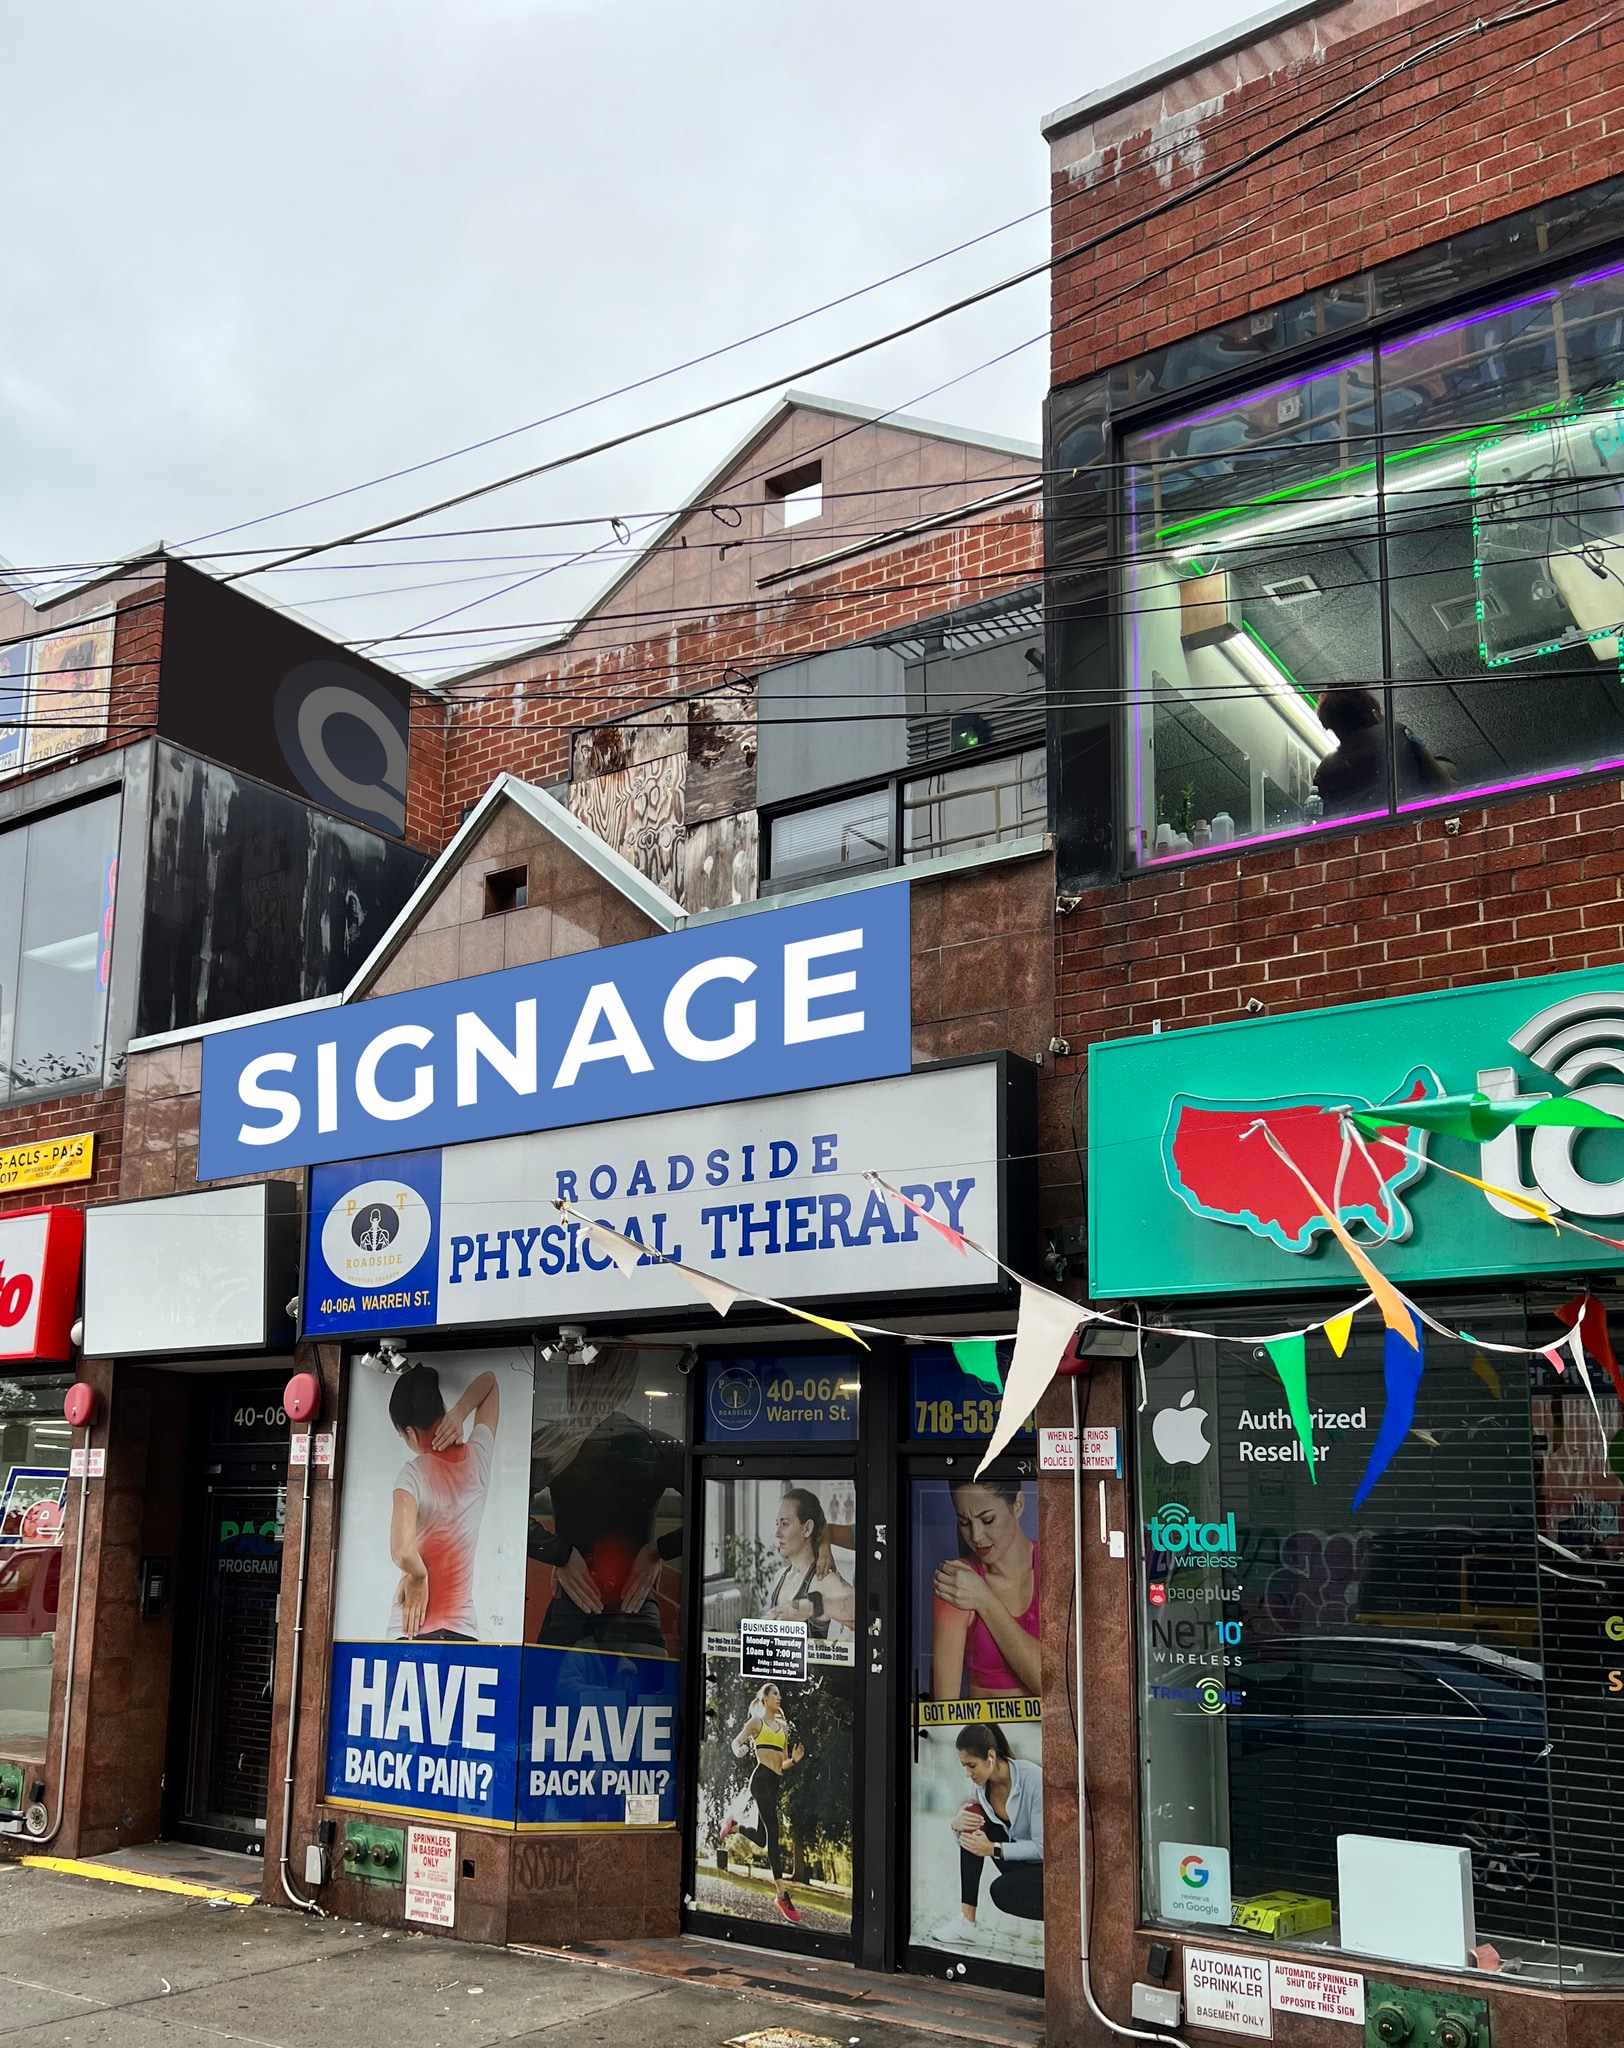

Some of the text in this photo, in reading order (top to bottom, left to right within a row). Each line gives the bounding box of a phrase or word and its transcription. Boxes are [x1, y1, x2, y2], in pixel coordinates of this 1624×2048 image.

[236, 927, 865, 1146] SIGNAGE
[52, 1143, 83, 1160] PALS
[555, 1133, 838, 1203] ROADSIDE
[346, 1193, 408, 1217] P T
[449, 1177, 975, 1284] PHYSICAL THERAPY
[346, 1254, 403, 1269] ROADSIDE
[320, 1290, 431, 1314] 40-06A WARREN ST.
[766, 1378, 850, 1402] 40-06A
[234, 1406, 286, 1426] 40-06
[766, 1404, 850, 1422] Warren St.
[1237, 1406, 1366, 1430] Authrized
[1047, 1431, 1067, 1440] WHEN
[1087, 1431, 1109, 1440] RINGS
[1055, 1444, 1073, 1453] CALL
[1090, 1443, 1101, 1453] OR
[1043, 1456, 1114, 1466] POLICE DARTMENT
[1146, 1511, 1237, 1553] total
[218, 1558, 279, 1574] PROGRAM
[1174, 1552, 1239, 1568] wireless
[1168, 1585, 1241, 1604] pageplus
[743, 1622, 805, 1635] BUSINESS HOURS
[746, 1636, 770, 1647] Monday
[774, 1637, 802, 1649] Thursday
[746, 1647, 802, 1660] 10am to 7:00 pm
[1153, 1652, 1242, 1667] WIRELESS
[347, 1657, 499, 1752] HAVE
[923, 1699, 1041, 1721] GOT PAIN? TIENE DO
[530, 1706, 673, 1763] HAVE
[344, 1747, 493, 1801] BACK PAIN?
[529, 1769, 670, 1796] BACK PAIN?
[413, 1832, 451, 1847] SPRINKLERS
[411, 1843, 452, 1859] IN BASEMENT
[422, 1856, 439, 1867] ONLY
[1181, 1893, 1201, 1902] review
[1172, 1901, 1184, 1910] on
[1186, 1902, 1219, 1915] Google
[1190, 1958, 1262, 1982] AUTOMATIC
[1274, 1965, 1359, 1988] AUTOMATIC SPRINKLER
[1193, 1975, 1263, 1998] SPRINKLER
[1286, 1977, 1347, 1996] SHUT OFF VALVE
[1225, 2000, 1234, 2010] IN
[1280, 1995, 1355, 2017] OPPOSITE THIS SIGN
[1322, 1993, 1341, 2004] FEET
[1196, 2006, 1265, 2027] BASEMENT ONLY
